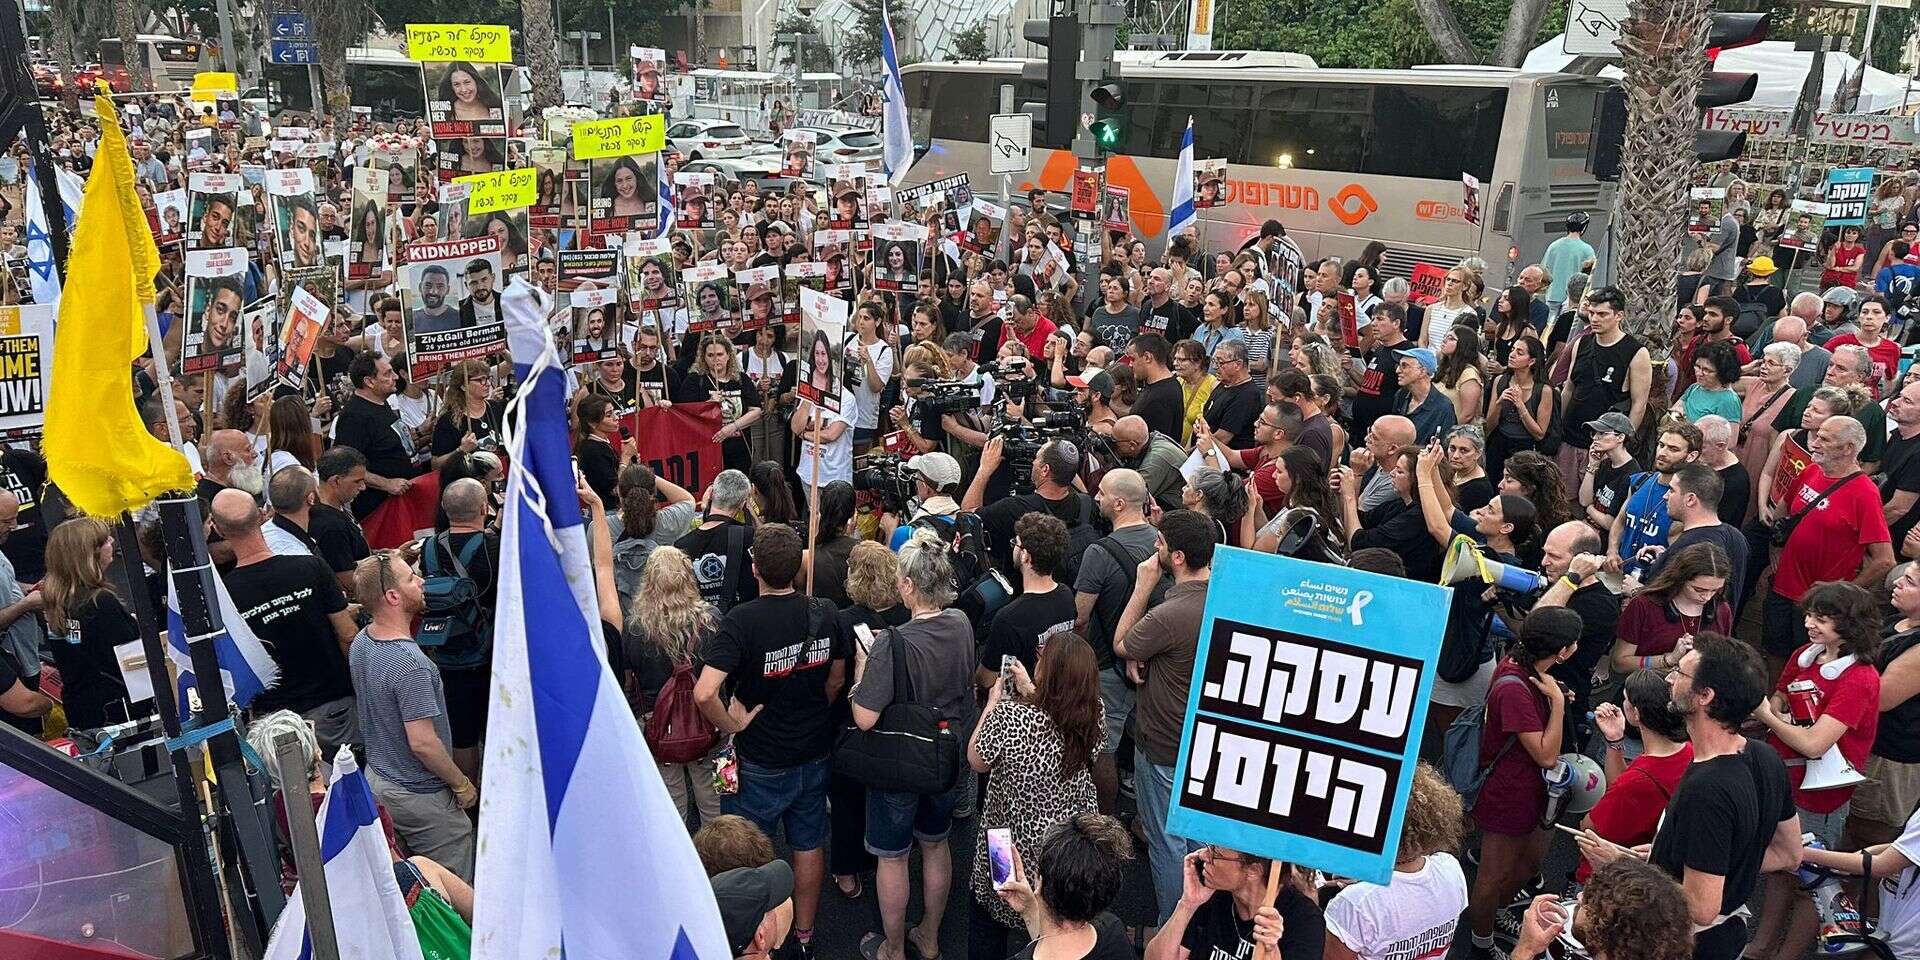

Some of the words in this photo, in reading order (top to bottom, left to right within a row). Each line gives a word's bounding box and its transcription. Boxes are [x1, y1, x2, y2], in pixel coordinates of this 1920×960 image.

[430, 101, 452, 111] BRING
[432, 112, 446, 121] HER
[1812, 112, 1890, 142] ממשל
[440, 161, 452, 169] HER
[1226, 180, 1319, 211] מטרופול
[1828, 183, 1869, 200] עסקה.
[410, 239, 497, 260] KIDNAPPED
[421, 332, 463, 344] Ziv&Gali
[466, 325, 501, 337] Berman
[437, 341, 457, 350] years
[459, 338, 470, 346] old
[419, 354, 443, 362] BRING
[445, 351, 465, 360] THEM
[466, 347, 486, 357] HOME
[0, 353, 40, 379] ME
[0, 379, 41, 414] OW!
[271, 595, 293, 606] מקום
[293, 588, 312, 599] לכל
[1204, 631, 1418, 739] עסקה.
[1187, 721, 1388, 838] היום!
